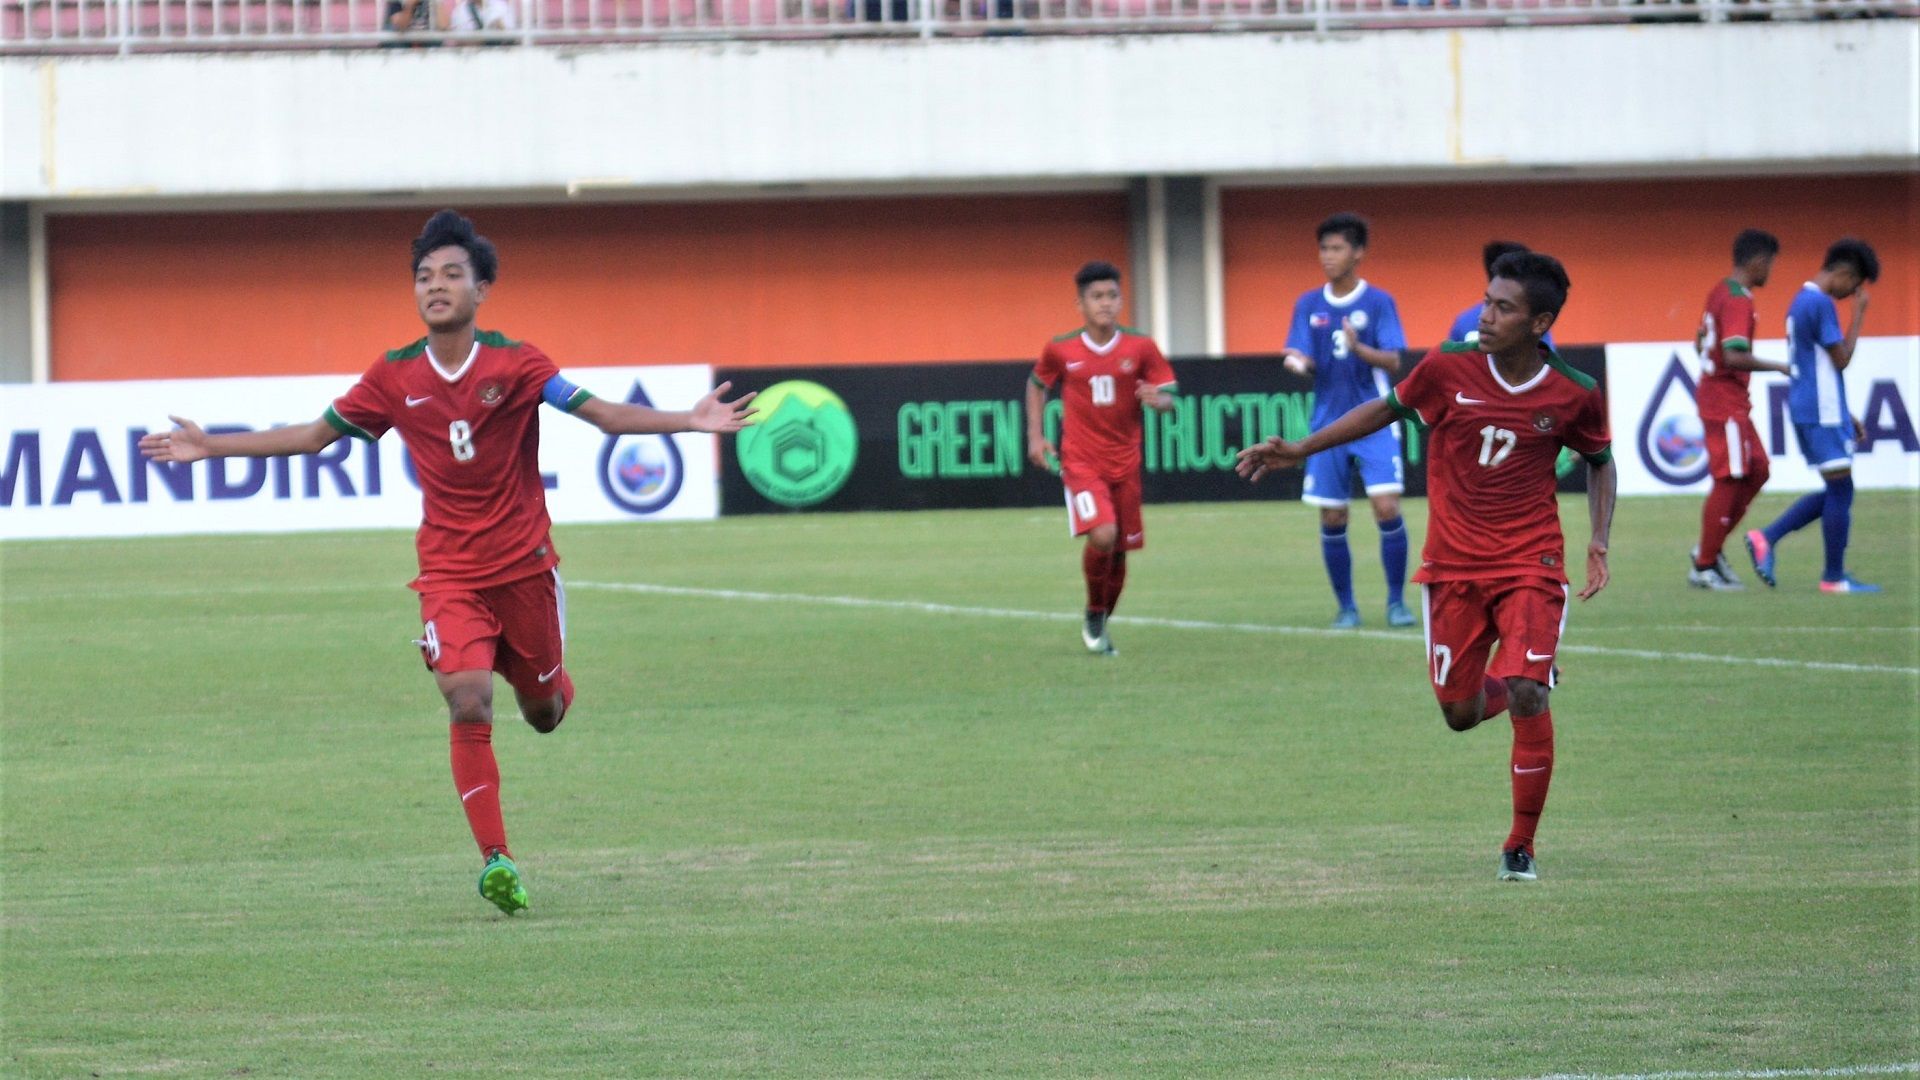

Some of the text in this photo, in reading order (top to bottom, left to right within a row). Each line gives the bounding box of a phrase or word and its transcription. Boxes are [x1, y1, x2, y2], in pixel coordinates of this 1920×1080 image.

[1088, 374, 1116, 407] 10
[449, 420, 475, 461] 8
[898, 400, 1021, 478] GREEN
[1043, 391, 1316, 474] CTRUCTION
[1478, 424, 1517, 467] 17
